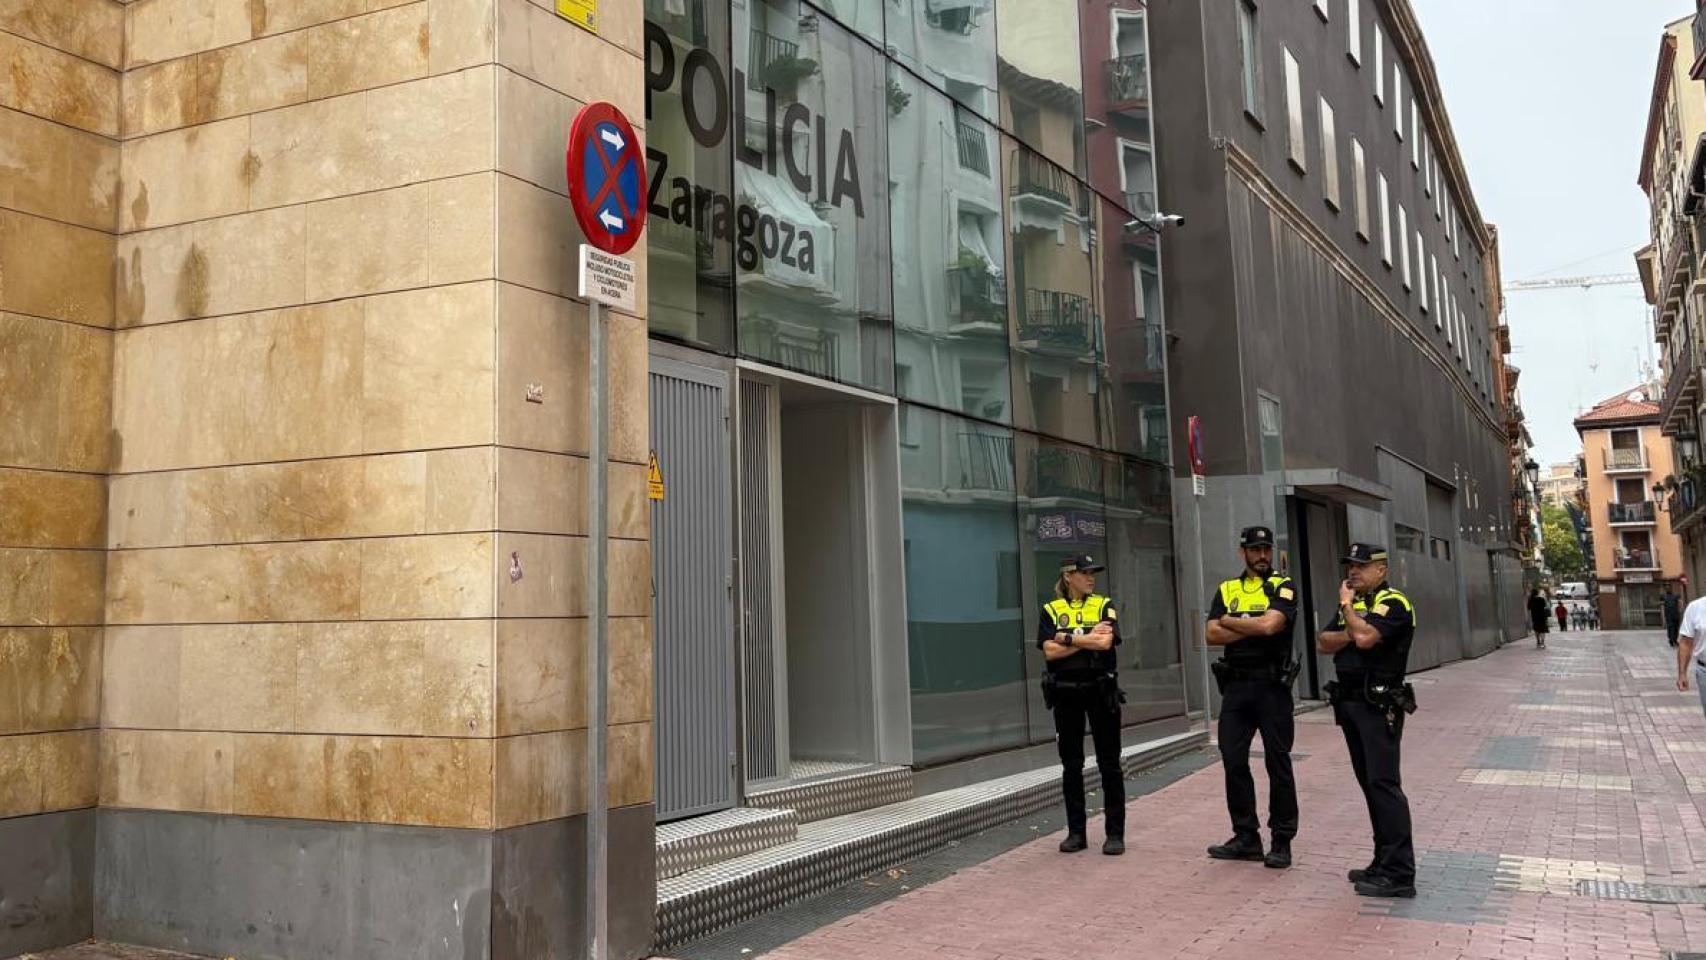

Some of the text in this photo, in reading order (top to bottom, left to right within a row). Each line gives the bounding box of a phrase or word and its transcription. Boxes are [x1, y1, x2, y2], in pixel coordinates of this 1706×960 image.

[645, 19, 865, 219] POLICIA
[646, 146, 816, 274] Zaragoza
[590, 251, 613, 266] SEGURIDAD
[586, 261, 604, 273] INCLUSO
[608, 289, 621, 298] ACERA
